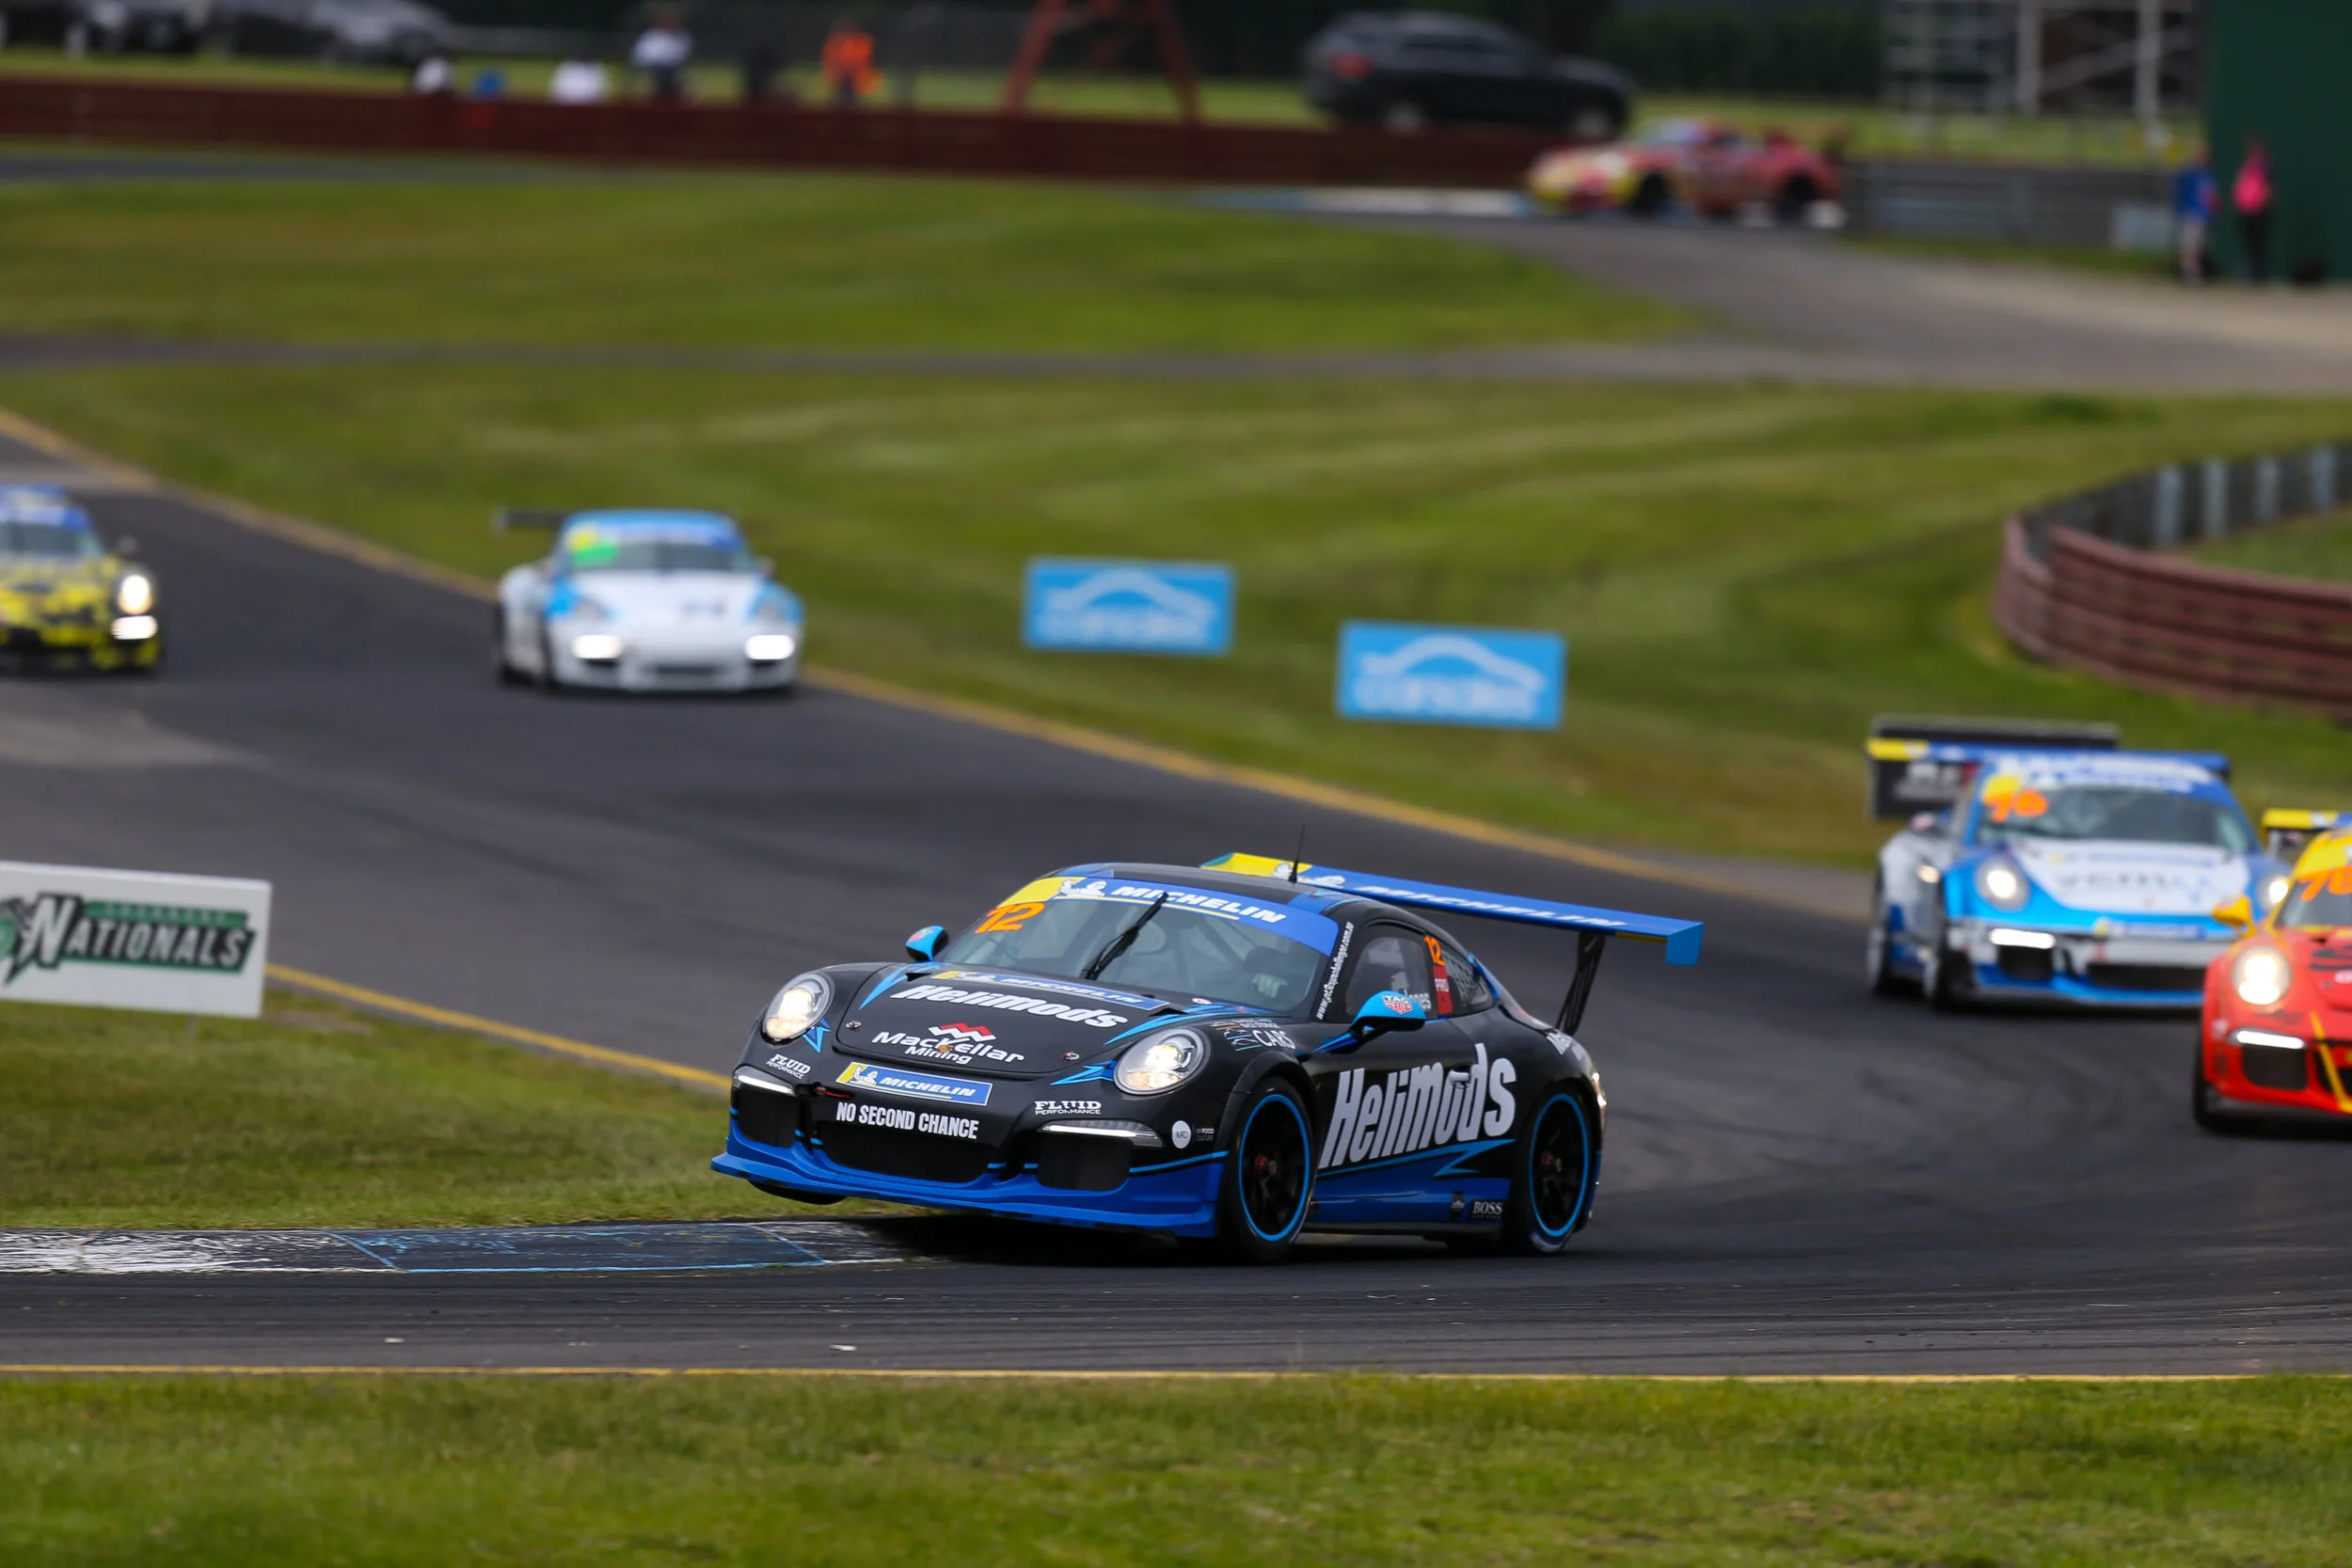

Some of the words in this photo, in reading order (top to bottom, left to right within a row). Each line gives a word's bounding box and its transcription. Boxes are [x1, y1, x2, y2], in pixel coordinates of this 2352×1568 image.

[975, 901, 1046, 934] 12
[1111, 885, 1287, 924] MICHELIN
[1357, 885, 1629, 927] MICHELIN
[17, 895, 248, 967] NATIONALS
[1423, 935, 1446, 967] 12
[1002, 977, 1145, 1004] MICHELIN
[1386, 995, 1409, 1004] TAG
[890, 985, 1129, 1029] Helimods
[1252, 1029, 1295, 1050] CARS
[769, 1053, 812, 1075] FLUID
[904, 1044, 974, 1065] Mining
[765, 1060, 806, 1081] PERFORMANCE
[880, 1076, 977, 1098] MICHELIN
[1034, 1101, 1102, 1110] FLUID
[1317, 1042, 1518, 1170] Helimods
[835, 1101, 857, 1122] NO
[858, 1105, 916, 1131] SECOND
[918, 1113, 980, 1140] CHANCE
[1472, 1200, 1504, 1215] BOSS
